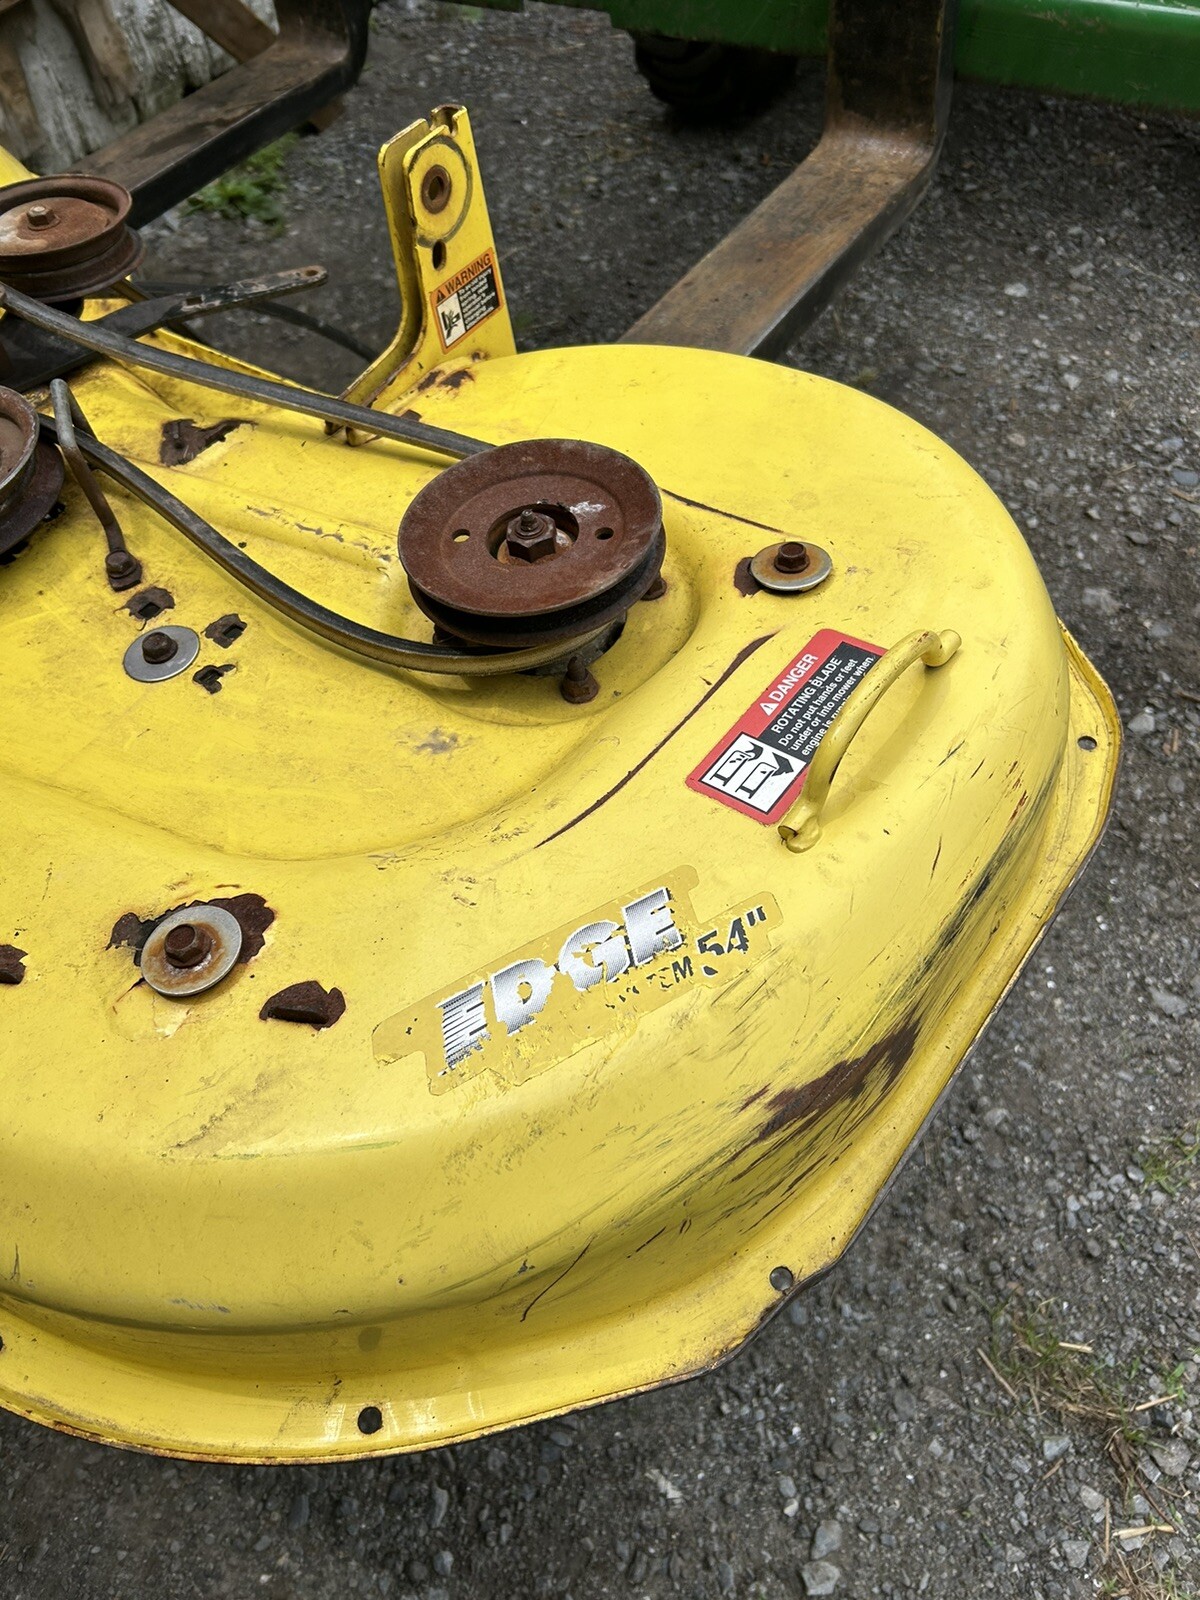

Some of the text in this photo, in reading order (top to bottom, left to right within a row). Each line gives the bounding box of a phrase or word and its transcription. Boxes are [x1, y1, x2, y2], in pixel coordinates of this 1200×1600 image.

[444, 253, 491, 294] WARNING
[768, 653, 819, 702] DANGER
[770, 657, 843, 734] ROTATING BLADE
[778, 658, 858, 747] Do not put hands or feet
[790, 656, 874, 751] under or into mower when
[801, 728, 827, 756] engine
[435, 886, 685, 1078] EDGE
